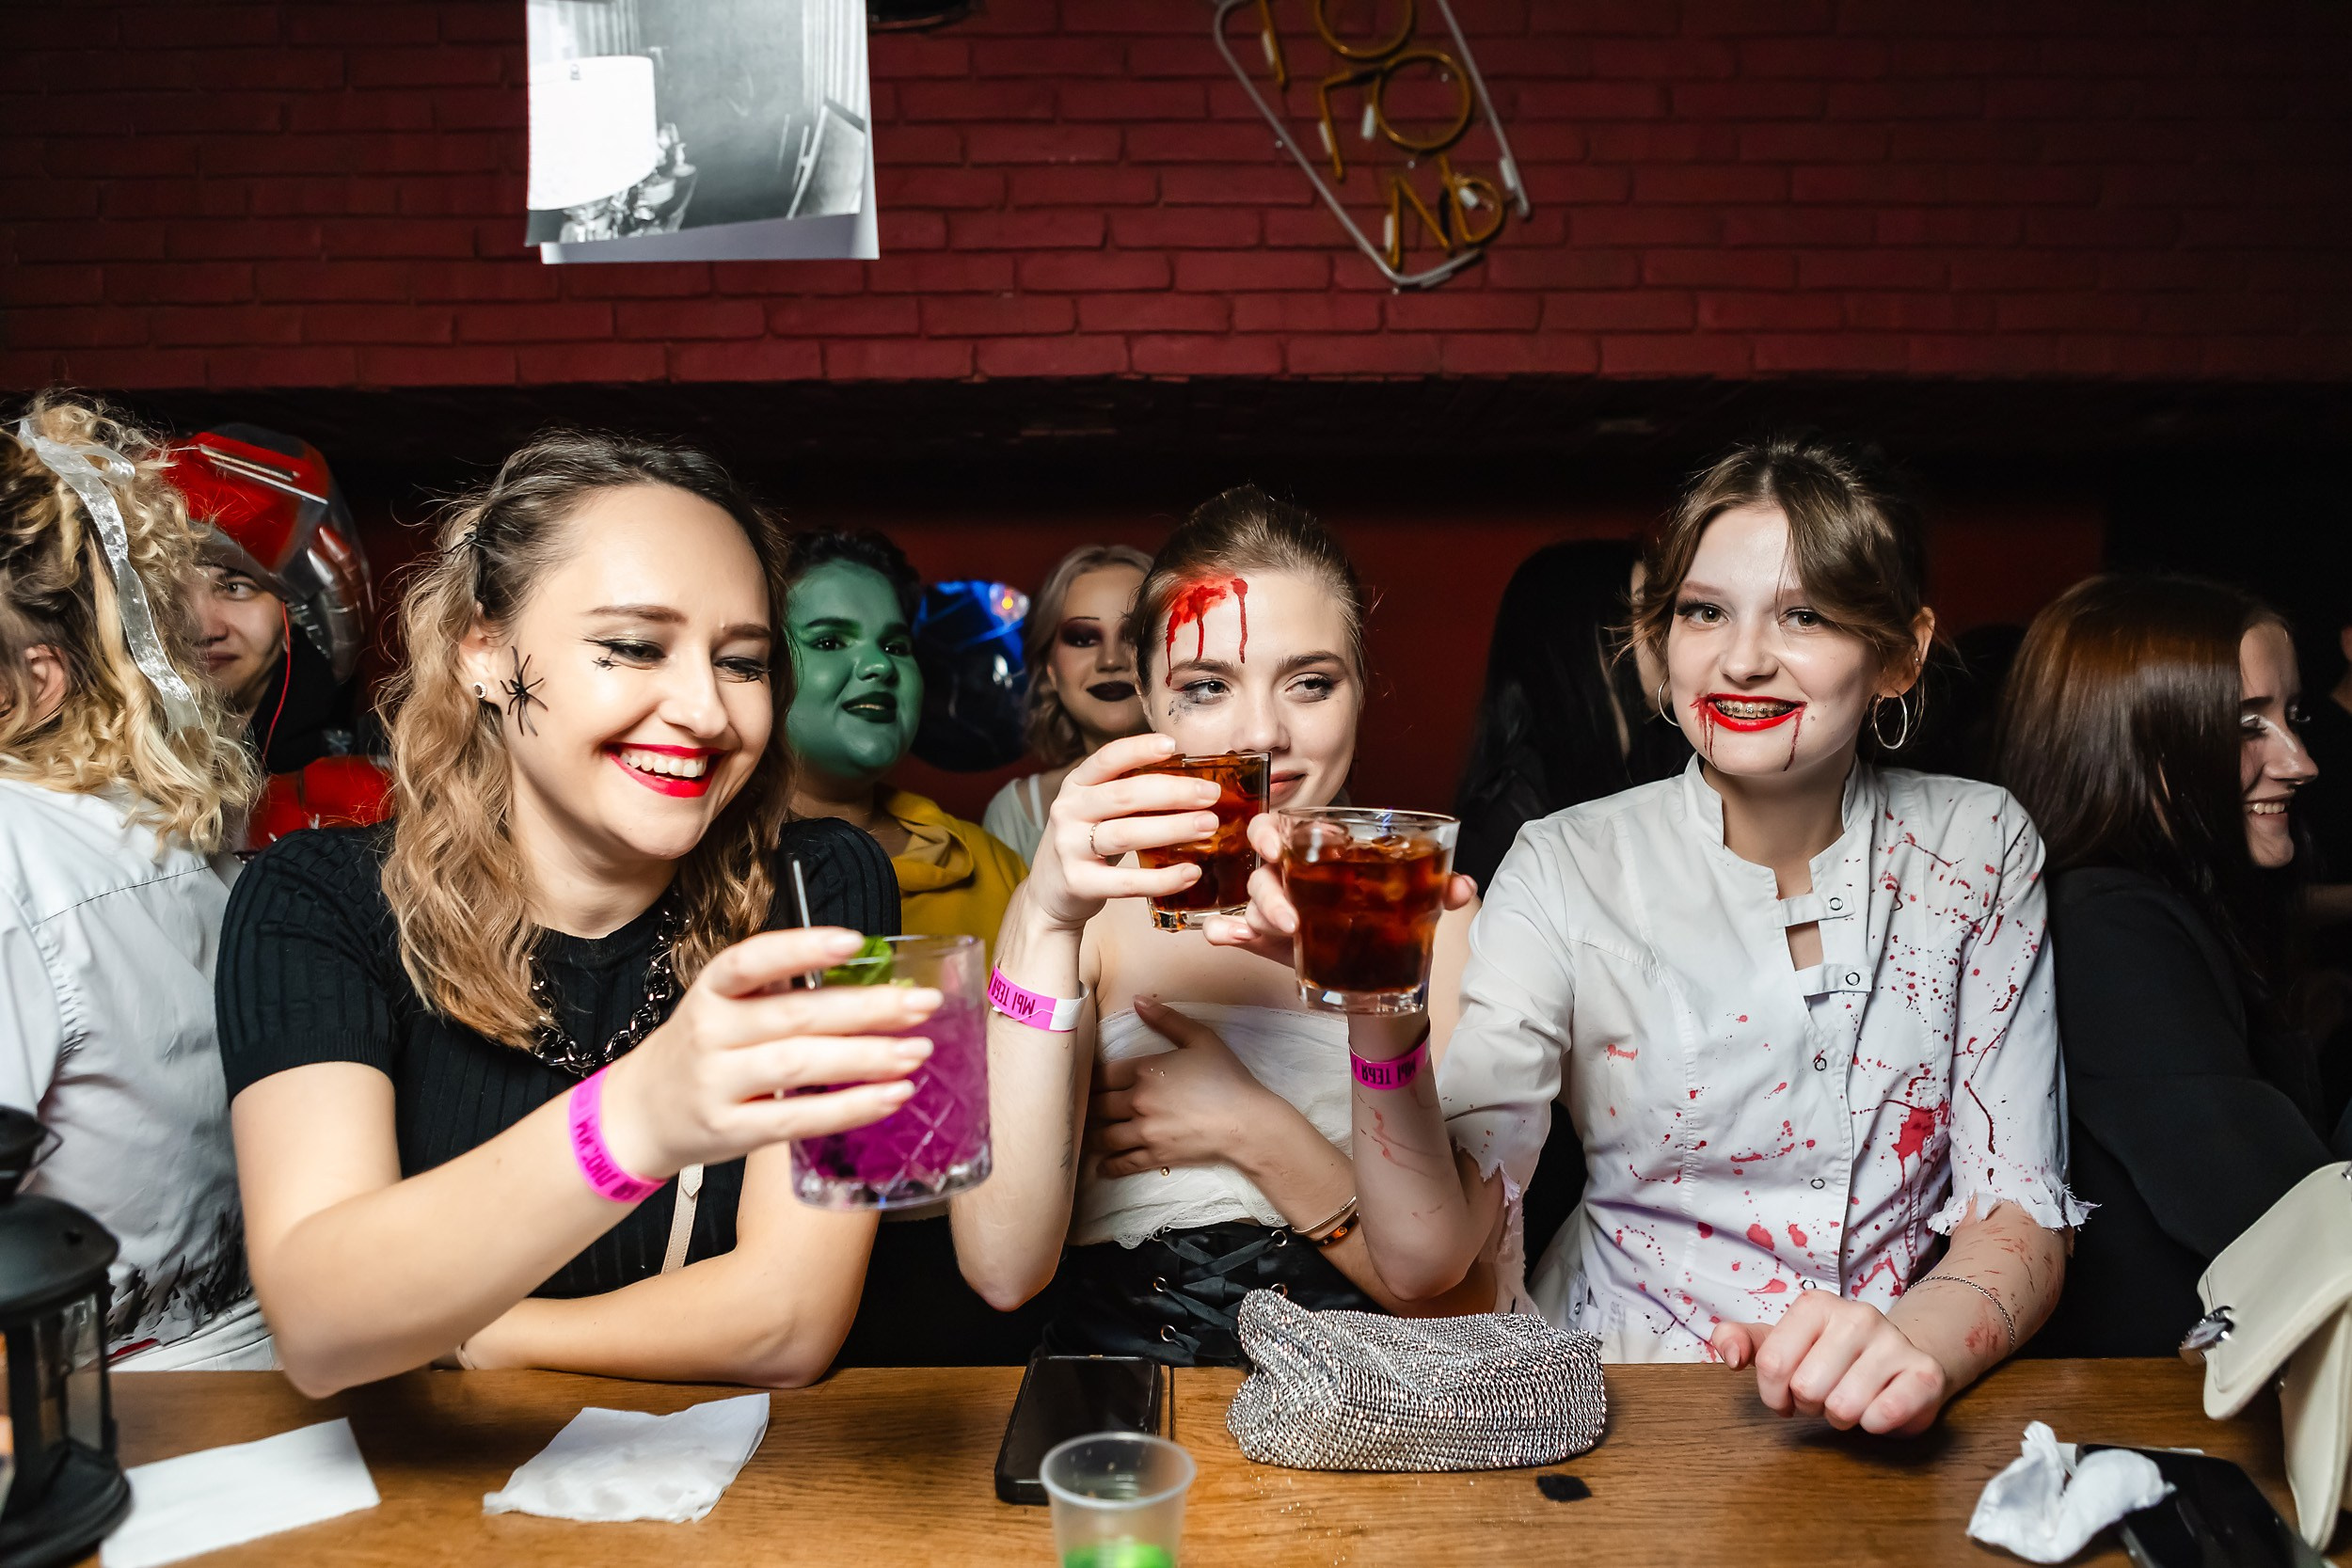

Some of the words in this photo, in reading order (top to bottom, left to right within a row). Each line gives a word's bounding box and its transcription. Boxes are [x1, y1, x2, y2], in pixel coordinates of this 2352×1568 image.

[991, 976, 1010, 1006] ТЕБЯ
[1011, 991, 1036, 1018] МЫ
[1360, 1063, 1391, 1085] ТЕБЯ
[1397, 1056, 1416, 1083] МЫ
[575, 1114, 620, 1187] ЛЮИМ
